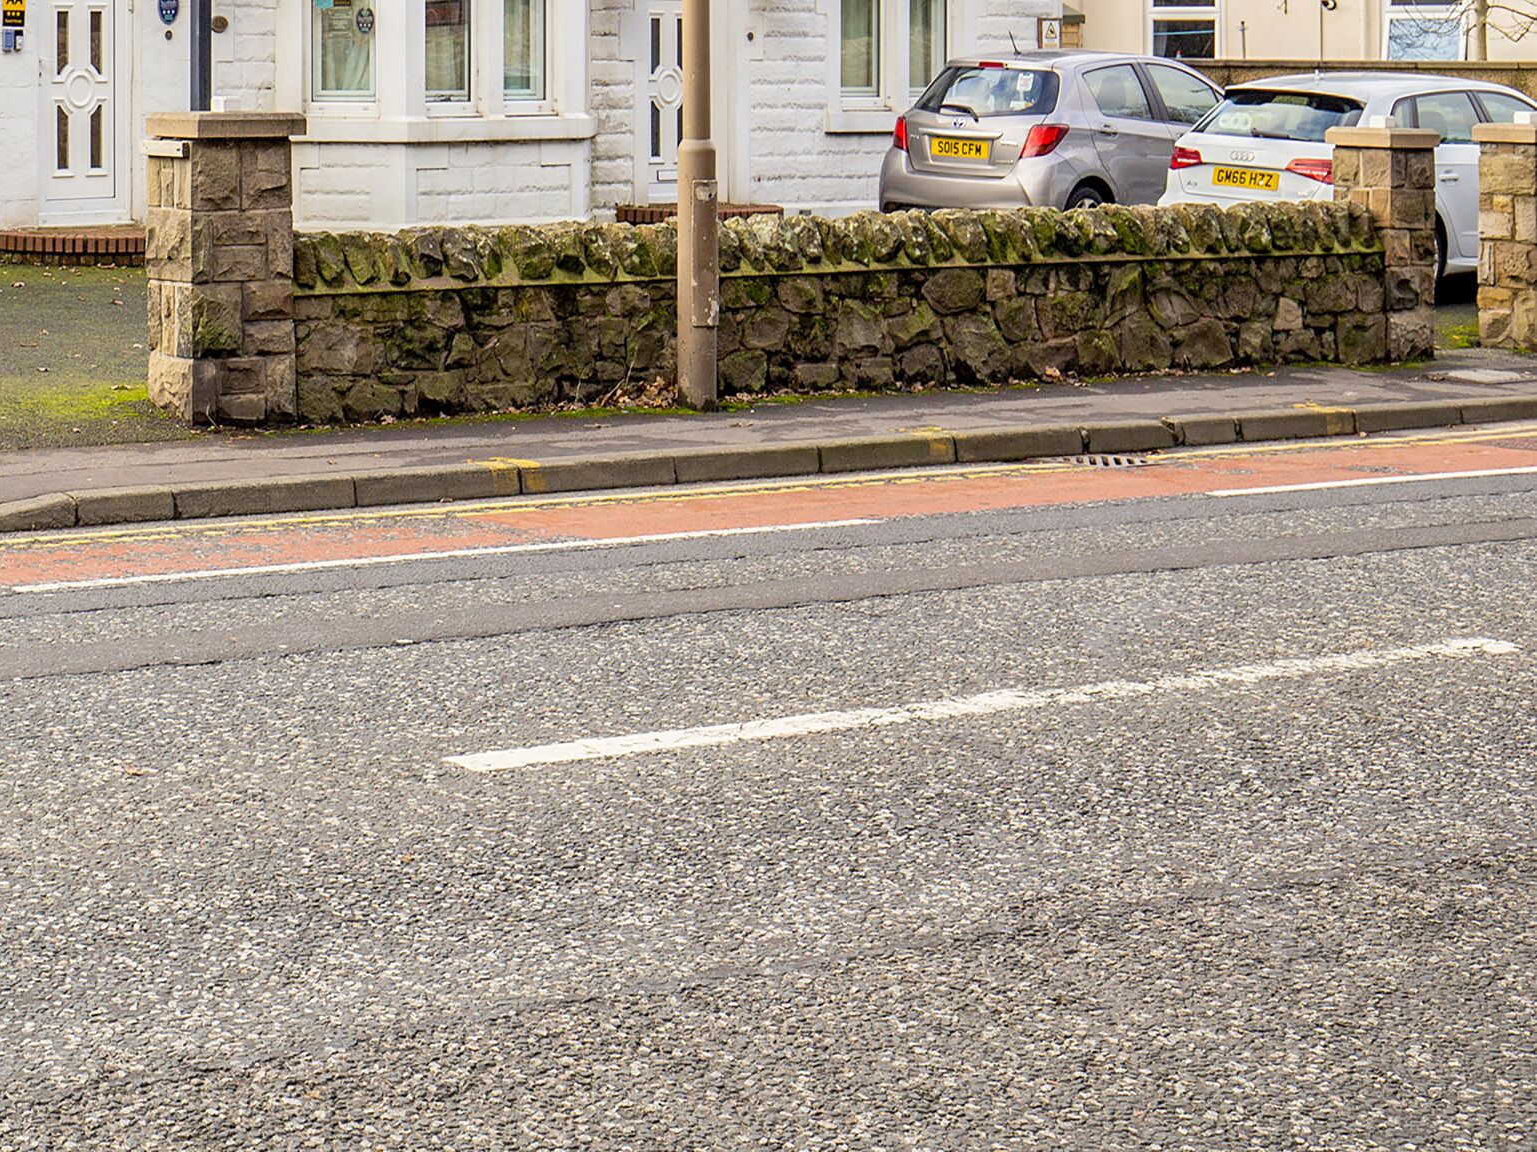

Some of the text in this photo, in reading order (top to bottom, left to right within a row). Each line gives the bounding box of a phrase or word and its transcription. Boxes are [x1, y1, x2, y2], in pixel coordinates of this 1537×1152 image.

[937, 140, 982, 156] SO15 CFM
[1216, 169, 1246, 185] GM66
